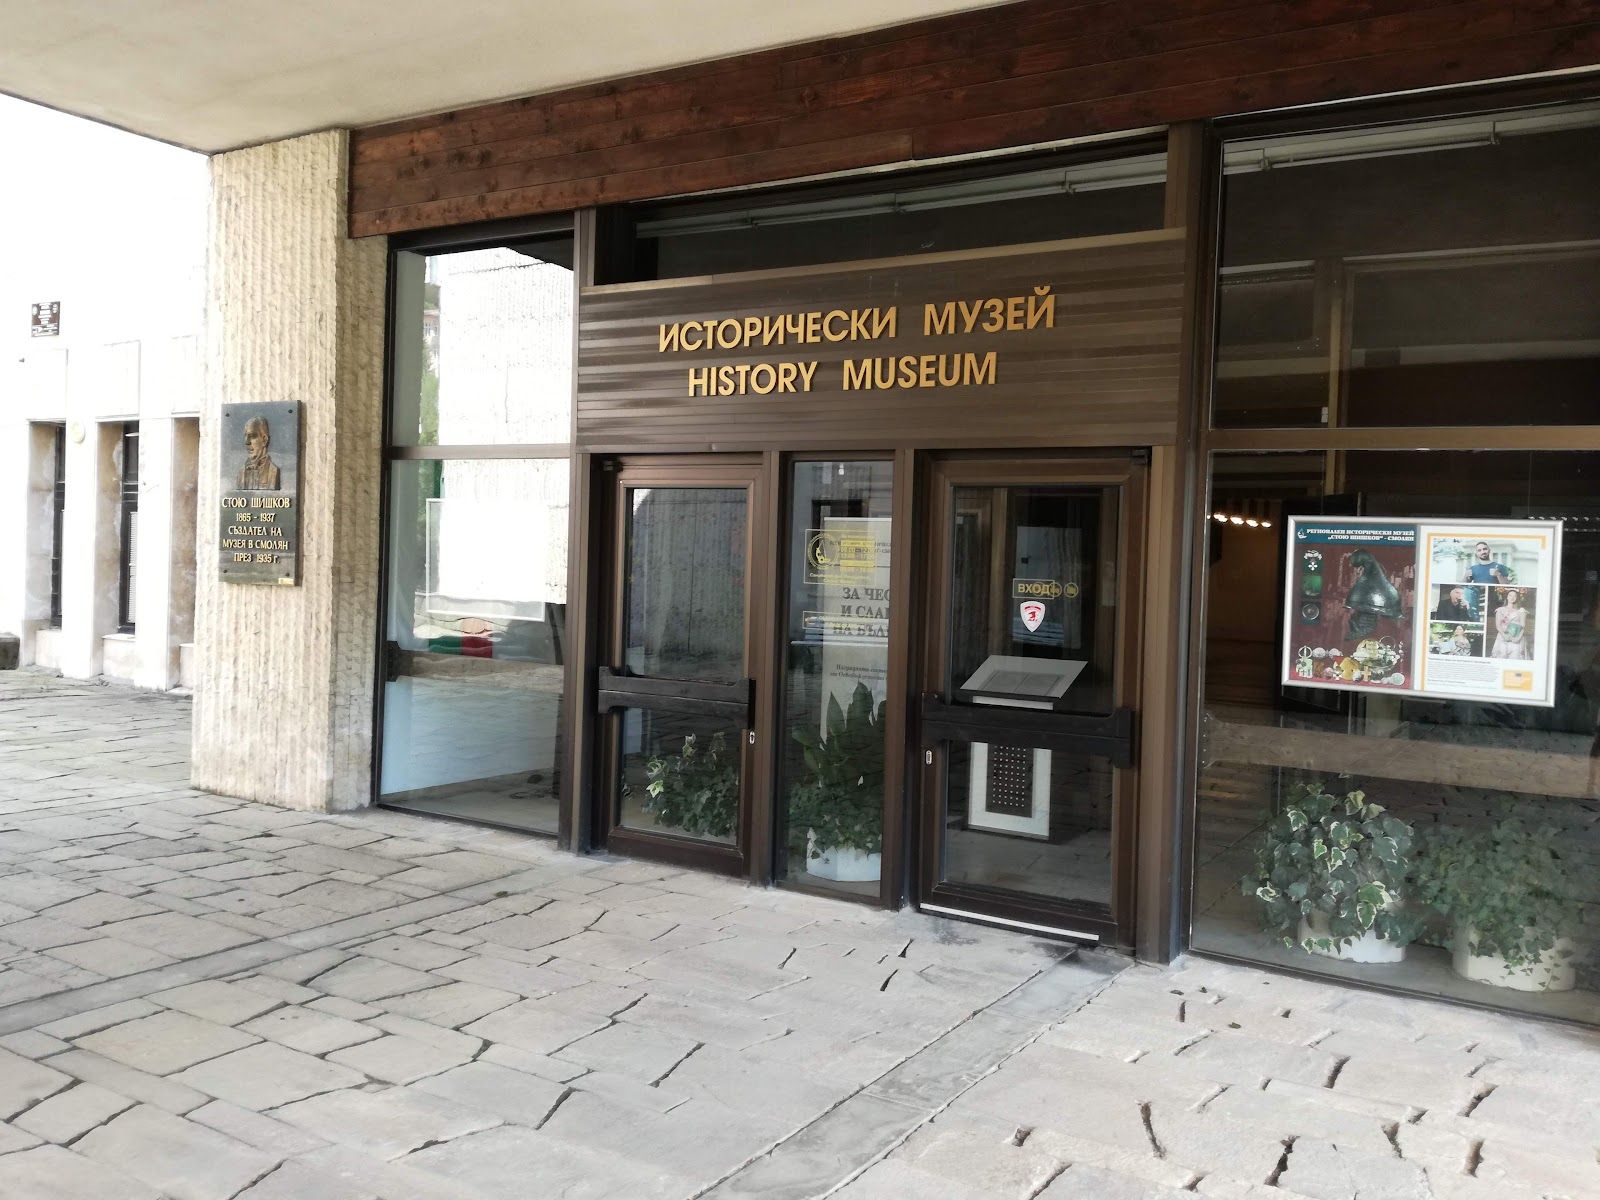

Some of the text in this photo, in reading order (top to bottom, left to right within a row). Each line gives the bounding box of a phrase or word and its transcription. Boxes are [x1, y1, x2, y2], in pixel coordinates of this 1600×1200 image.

[658, 285, 1056, 353] ИСТОРИЧЕСКИ МУЗЕЙ
[688, 351, 997, 397] HISTORY MUSEUM
[222, 497, 291, 509] СТОЮ ШИШКОВ
[236, 512, 252, 522] 1865
[260, 512, 276, 523] 1937
[228, 525, 282, 537] СЪЗДАТЕЛ НА
[222, 539, 289, 551] МУЗЕЯ В СМОЛЯН
[234, 552, 252, 562] ПРЕЗ
[256, 553, 272, 563] 1935
[842, 587, 861, 600] ЗА
[1018, 583, 1051, 595] ВХОД
[840, 605, 853, 618] И
